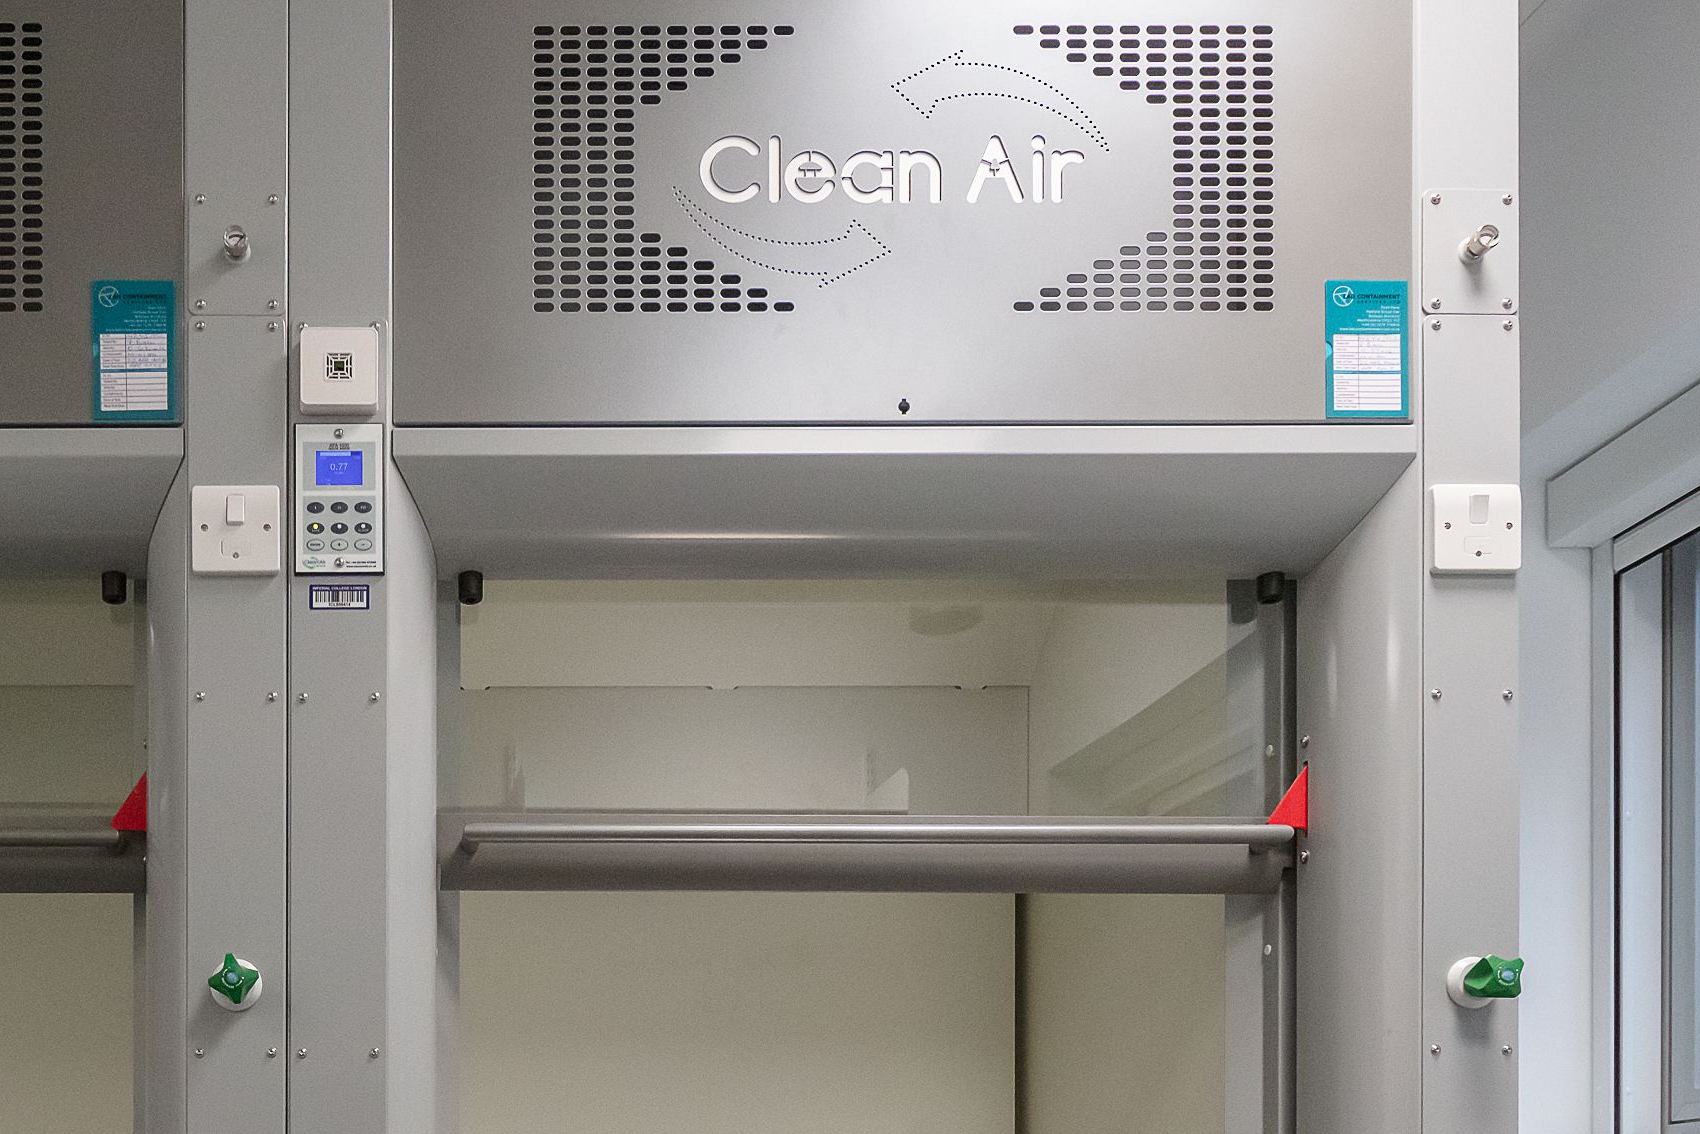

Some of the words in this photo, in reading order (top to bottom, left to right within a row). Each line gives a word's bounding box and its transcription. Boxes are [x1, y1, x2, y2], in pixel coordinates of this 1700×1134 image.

[699, 134, 943, 204] Clean
[966, 134, 1085, 204] Air
[329, 462, 349, 471] 0.77
